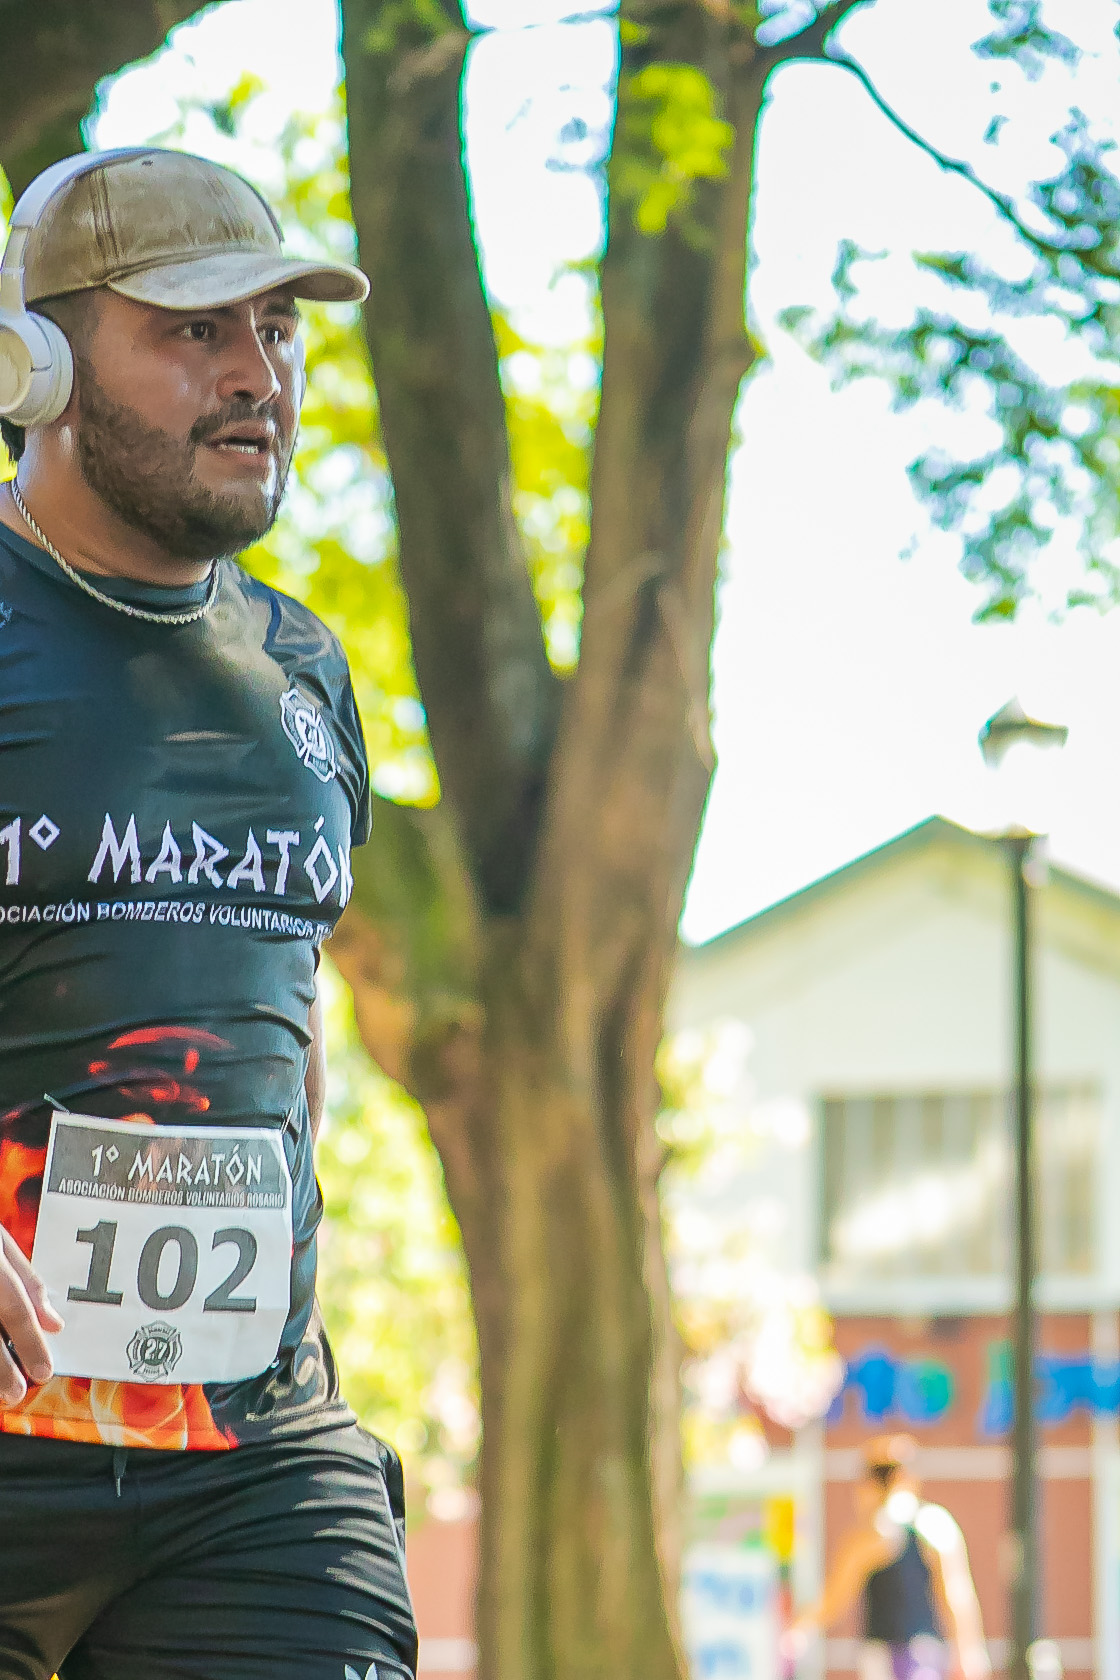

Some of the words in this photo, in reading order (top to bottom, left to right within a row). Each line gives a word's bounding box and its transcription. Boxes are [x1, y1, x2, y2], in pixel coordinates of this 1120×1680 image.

[97, 902, 206, 923] BOMBEROS
[128, 1143, 262, 1186] MARATÓN
[67, 1217, 258, 1314] 102
[144, 1338, 168, 1361] 27
